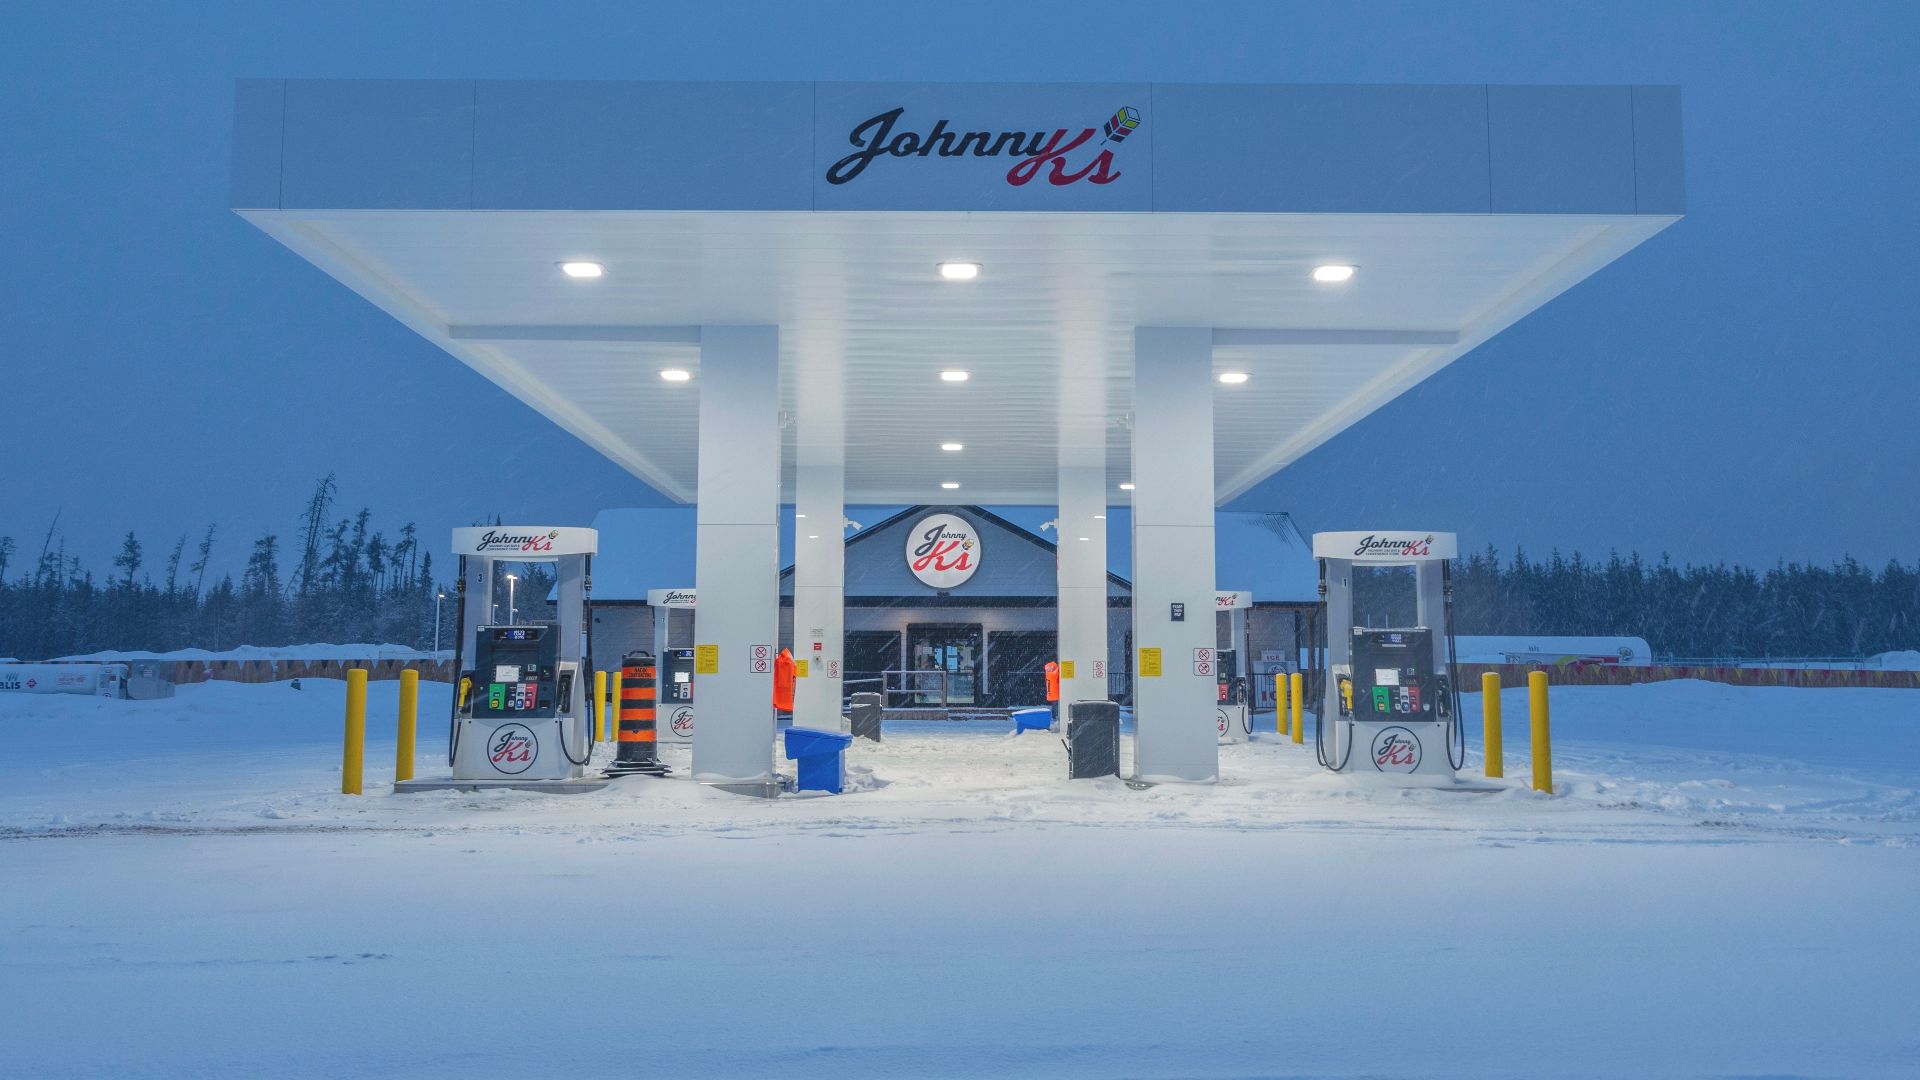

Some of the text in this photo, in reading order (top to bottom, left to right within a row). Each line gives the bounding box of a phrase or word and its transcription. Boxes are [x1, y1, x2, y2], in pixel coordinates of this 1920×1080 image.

[826, 106, 1052, 185] Johnny
[476, 530, 534, 551] Johnny
[914, 523, 967, 556] Johnny
[1354, 535, 1411, 556] Johnny
